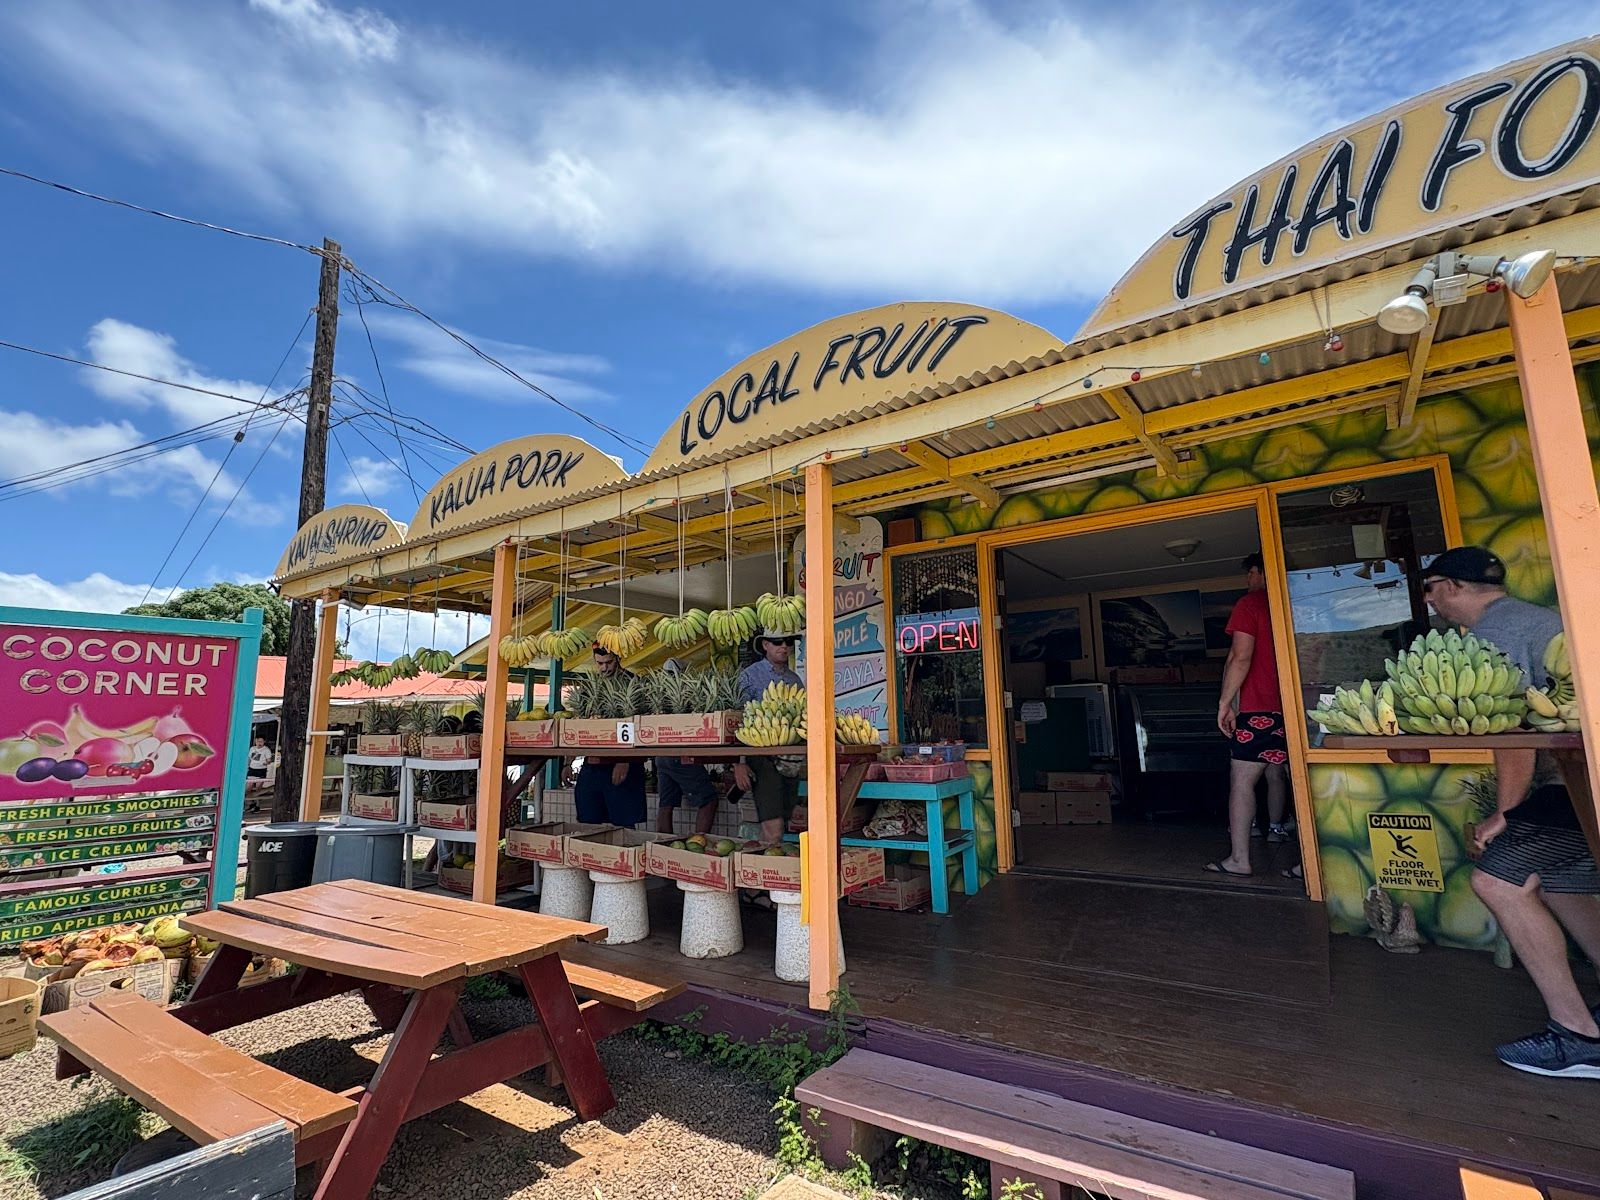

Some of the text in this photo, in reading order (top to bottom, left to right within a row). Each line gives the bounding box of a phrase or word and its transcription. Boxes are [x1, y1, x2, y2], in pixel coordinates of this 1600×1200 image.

[1172, 52, 1600, 300] THAI FO
[679, 315, 989, 456] LOCAL FRUIT
[430, 449, 585, 529] KALUA PORK
[325, 516, 388, 549] SHRIMP
[833, 552, 882, 580] RUIT
[899, 619, 978, 653] OPEN
[2, 634, 229, 668] COCONUT
[19, 668, 209, 696] CORNER
[0, 796, 200, 821] FRESH FRUITS SMOOTHIES
[1371, 816, 1430, 829] CAUTION
[16, 819, 182, 843] FRESH SLICED FRUITS
[51, 841, 148, 862] ICE CREAM
[258, 840, 284, 853] ACE
[1382, 868, 1435, 878] SLIPPERY
[1389, 860, 1425, 869] FLOOR
[1379, 876, 1440, 888] WHEN WET
[14, 882, 168, 913] FAMOUS CURRIES
[51, 914, 106, 933] APPLE
[113, 902, 182, 922] BANANA
